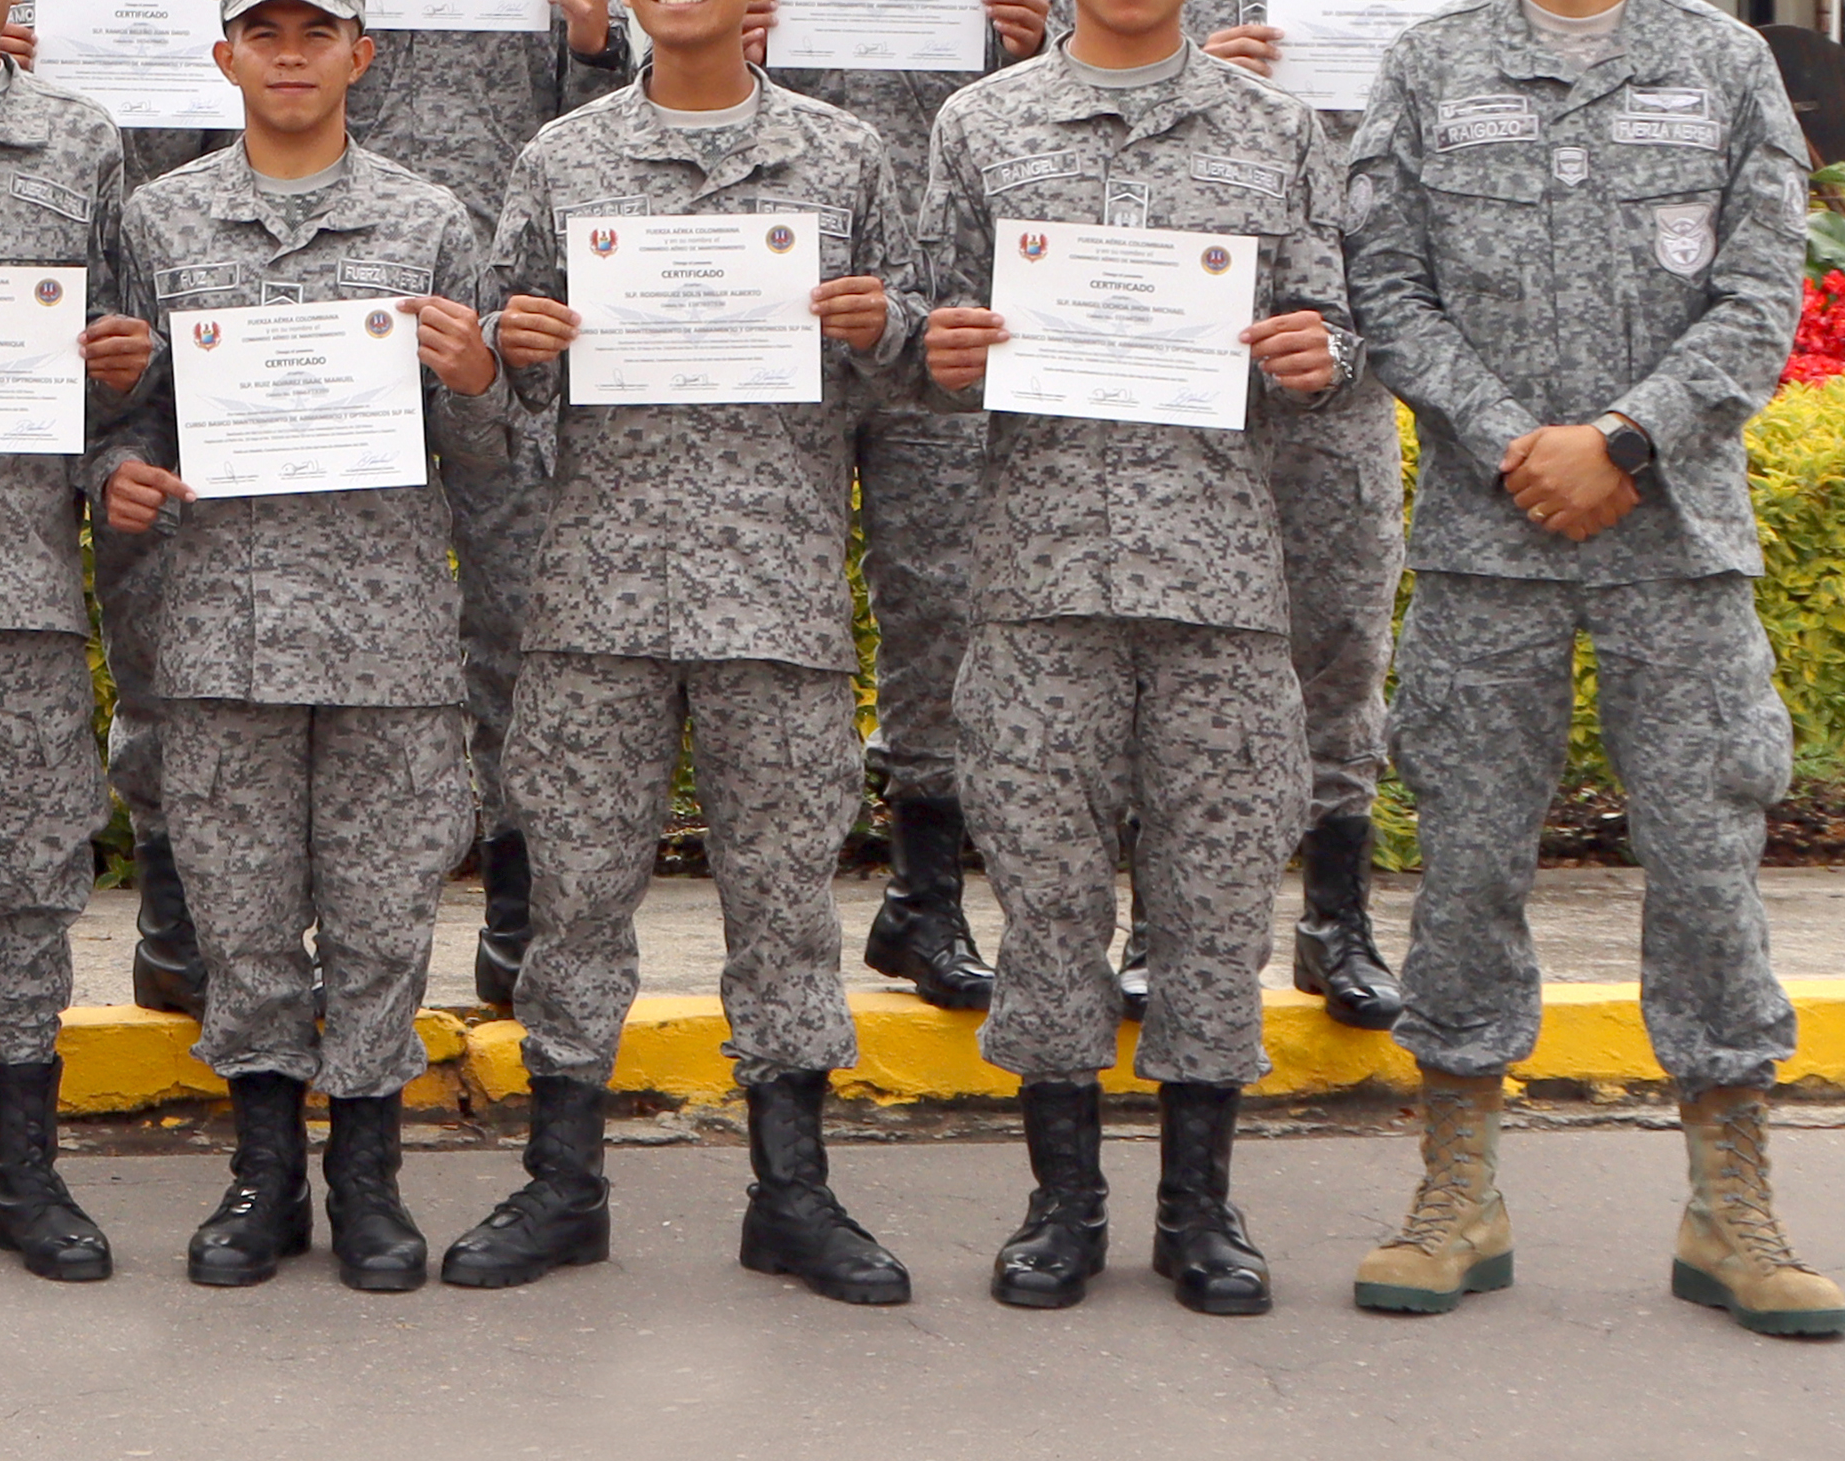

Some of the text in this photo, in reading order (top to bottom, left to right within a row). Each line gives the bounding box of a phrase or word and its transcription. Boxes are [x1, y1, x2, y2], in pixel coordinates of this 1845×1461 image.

[6, 8, 35, 24] AMO
[115, 10, 168, 19] CERTIFICADO
[1449, 120, 1520, 143] RAIGOZO
[1619, 122, 1714, 142] FUERZA AEREA
[1002, 160, 1059, 181] RANGEL
[1197, 158, 1241, 177] FUERZA
[672, 227, 693, 235] AÉREA
[1104, 238, 1126, 246] AÉREA
[1128, 240, 1175, 249] COLOMBIANA
[346, 266, 388, 284] FUERZA
[661, 269, 724, 279] CERTIFICADO
[1090, 280, 1155, 293] CERTIFICADO
[640, 290, 680, 298] RODRIGUEZ
[730, 289, 762, 297] ALBERTO
[1072, 300, 1100, 309] RANGEL
[247, 314, 339, 326] FUERZA AÉREA COLOMBIANA
[265, 356, 326, 368] CERTIFICADO
[324, 376, 354, 384] MANUEL
